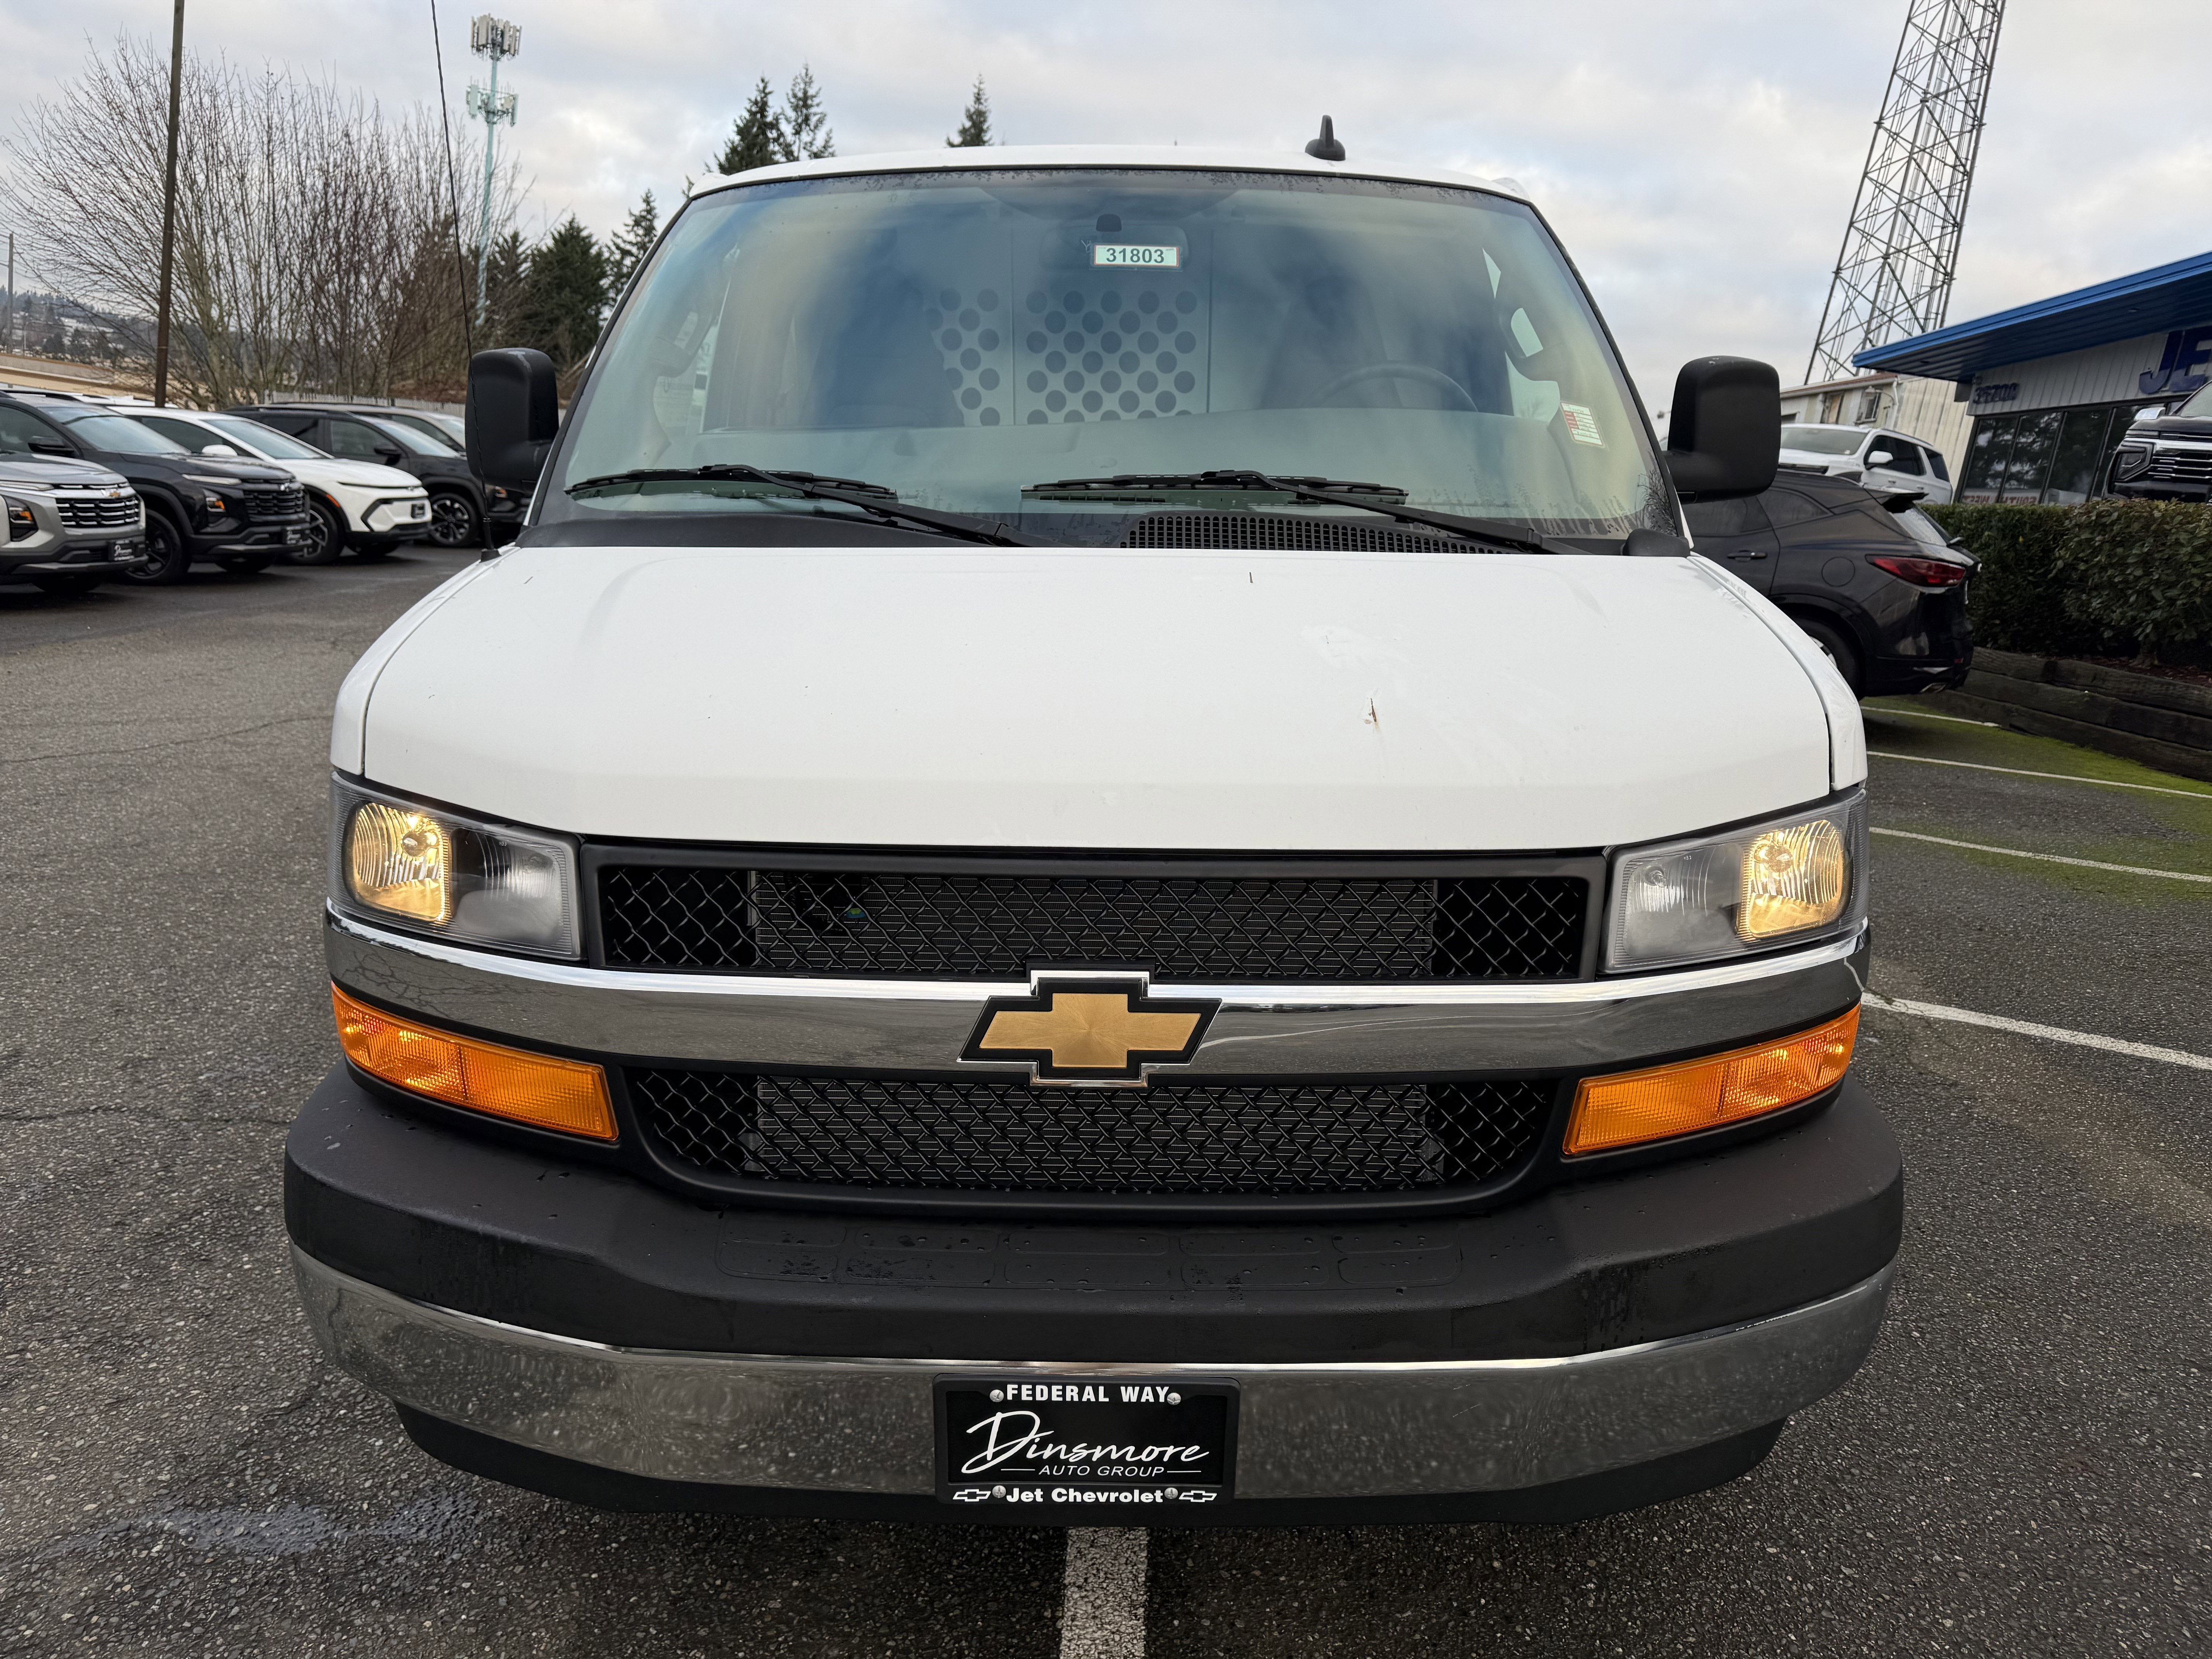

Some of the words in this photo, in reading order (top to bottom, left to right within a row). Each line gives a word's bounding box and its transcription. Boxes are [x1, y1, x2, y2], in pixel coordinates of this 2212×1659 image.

[1106, 248, 1164, 263] 31803
[1007, 1384, 1109, 1402] FEDERAL
[1120, 1386, 1169, 1402] WAY
[961, 1410, 1209, 1474] Dinsmore
[1039, 1465, 1090, 1475] AUTO
[1097, 1466, 1164, 1477] GROUP
[1006, 1488, 1043, 1502] Jet
[1051, 1488, 1163, 1503] Chevrolet
